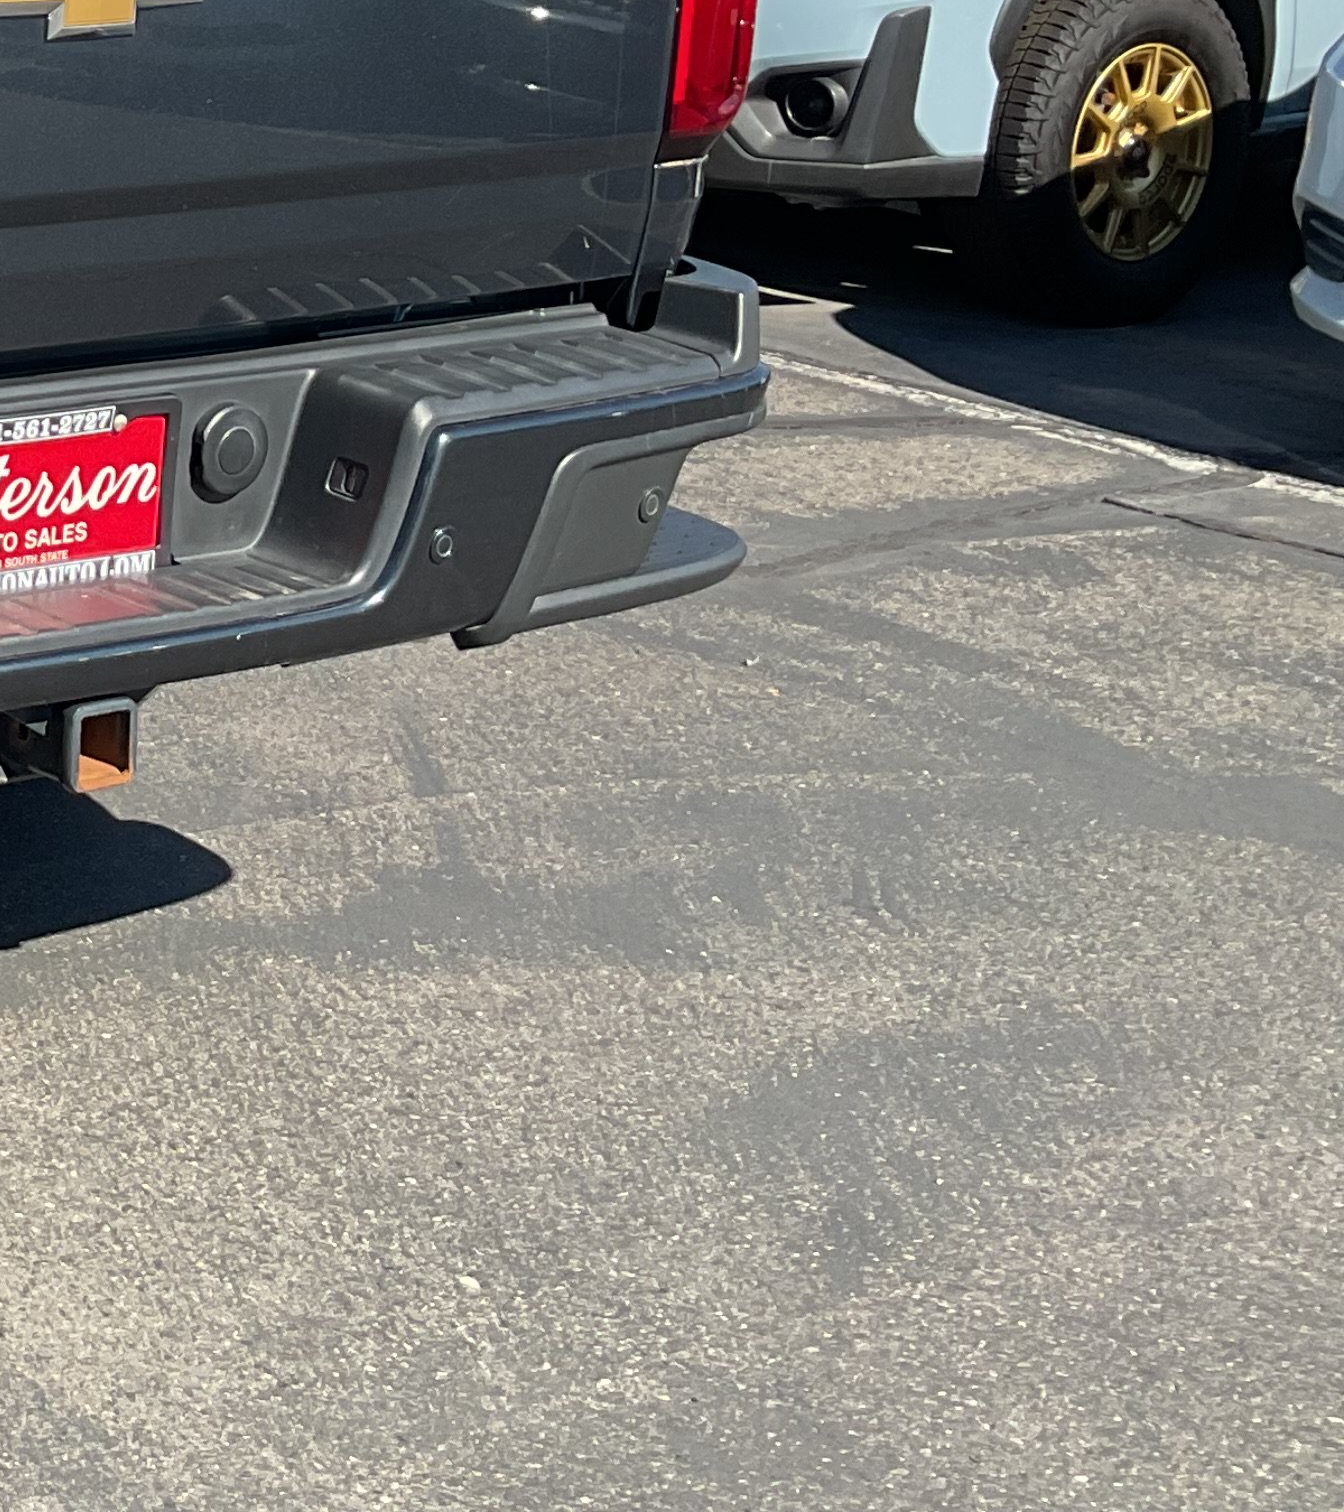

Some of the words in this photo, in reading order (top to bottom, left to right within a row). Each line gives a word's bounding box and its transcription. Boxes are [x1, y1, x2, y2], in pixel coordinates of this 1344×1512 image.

[24, 521, 88, 550] SALES
[4, 554, 38, 568] SOUTH
[40, 549, 69, 562] STATE
